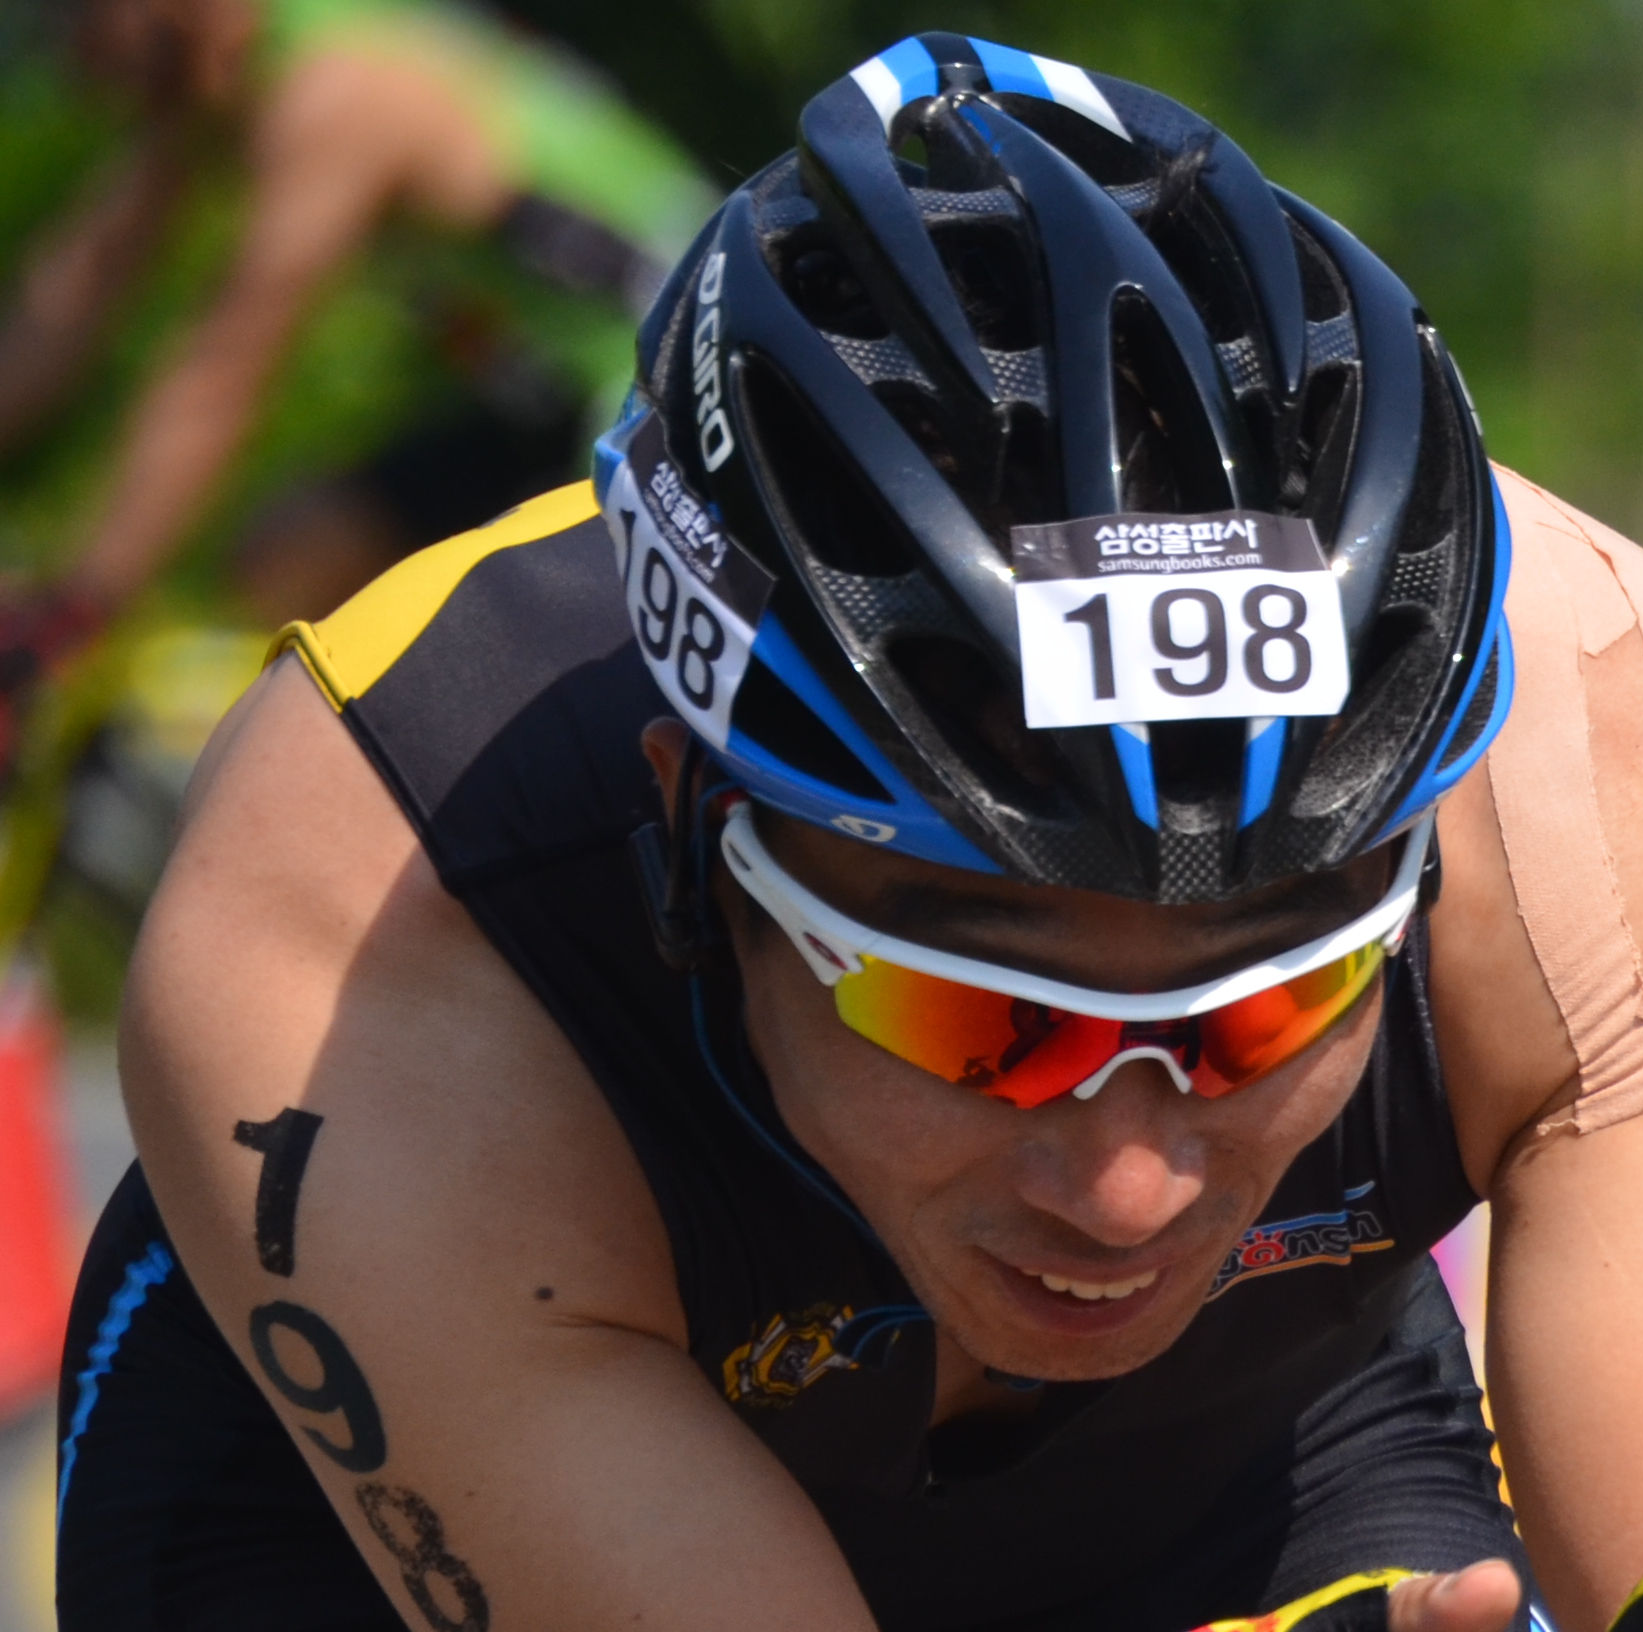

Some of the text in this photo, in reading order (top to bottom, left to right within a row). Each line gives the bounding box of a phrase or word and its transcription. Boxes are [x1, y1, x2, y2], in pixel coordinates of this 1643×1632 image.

[693, 307, 735, 473] GIRO
[1094, 518, 1258, 556] 삼성출판사
[1097, 552, 1262, 575] samsungbooks.com
[1063, 583, 1312, 700] 198
